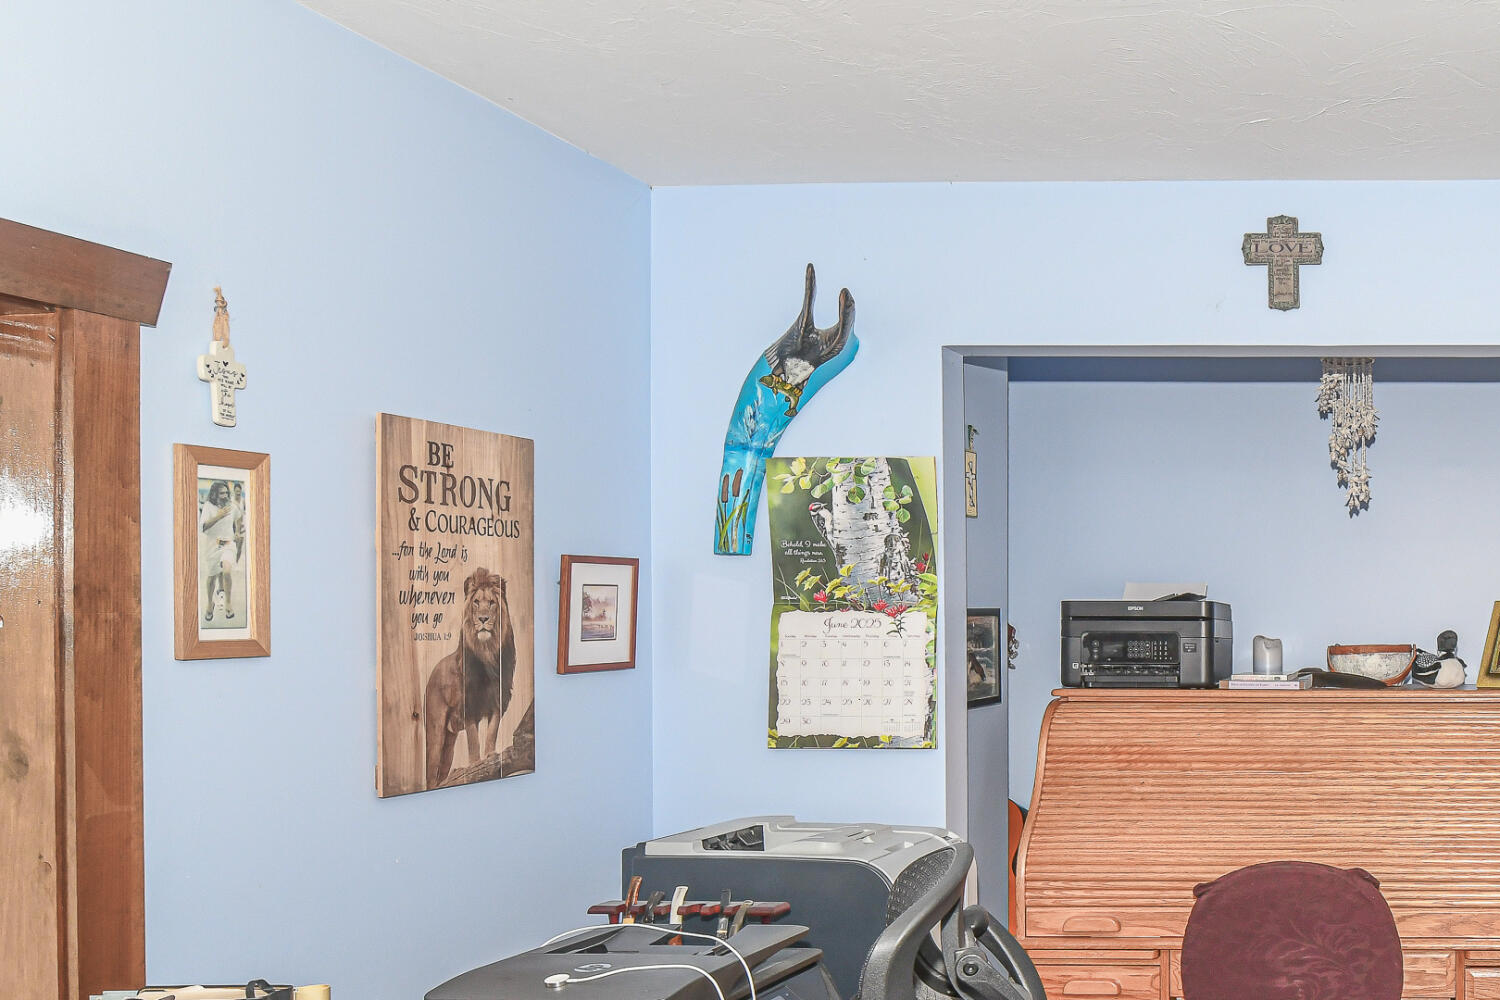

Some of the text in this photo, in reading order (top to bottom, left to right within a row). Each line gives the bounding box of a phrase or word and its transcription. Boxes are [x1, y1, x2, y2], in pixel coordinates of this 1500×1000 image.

[1254, 242, 1313, 254] LOVE
[427, 441, 454, 468] BE
[398, 464, 511, 514] STRONG
[408, 507, 520, 539] & COURAGEOUS
[419, 541, 433, 559] the
[434, 542, 458, 564] Lord
[461, 545, 468, 562] is
[409, 565, 450, 586] with you
[399, 584, 456, 608] wherever
[411, 612, 443, 630] you go
[823, 616, 882, 634] June 2025
[414, 632, 441, 641] JOSHUA
